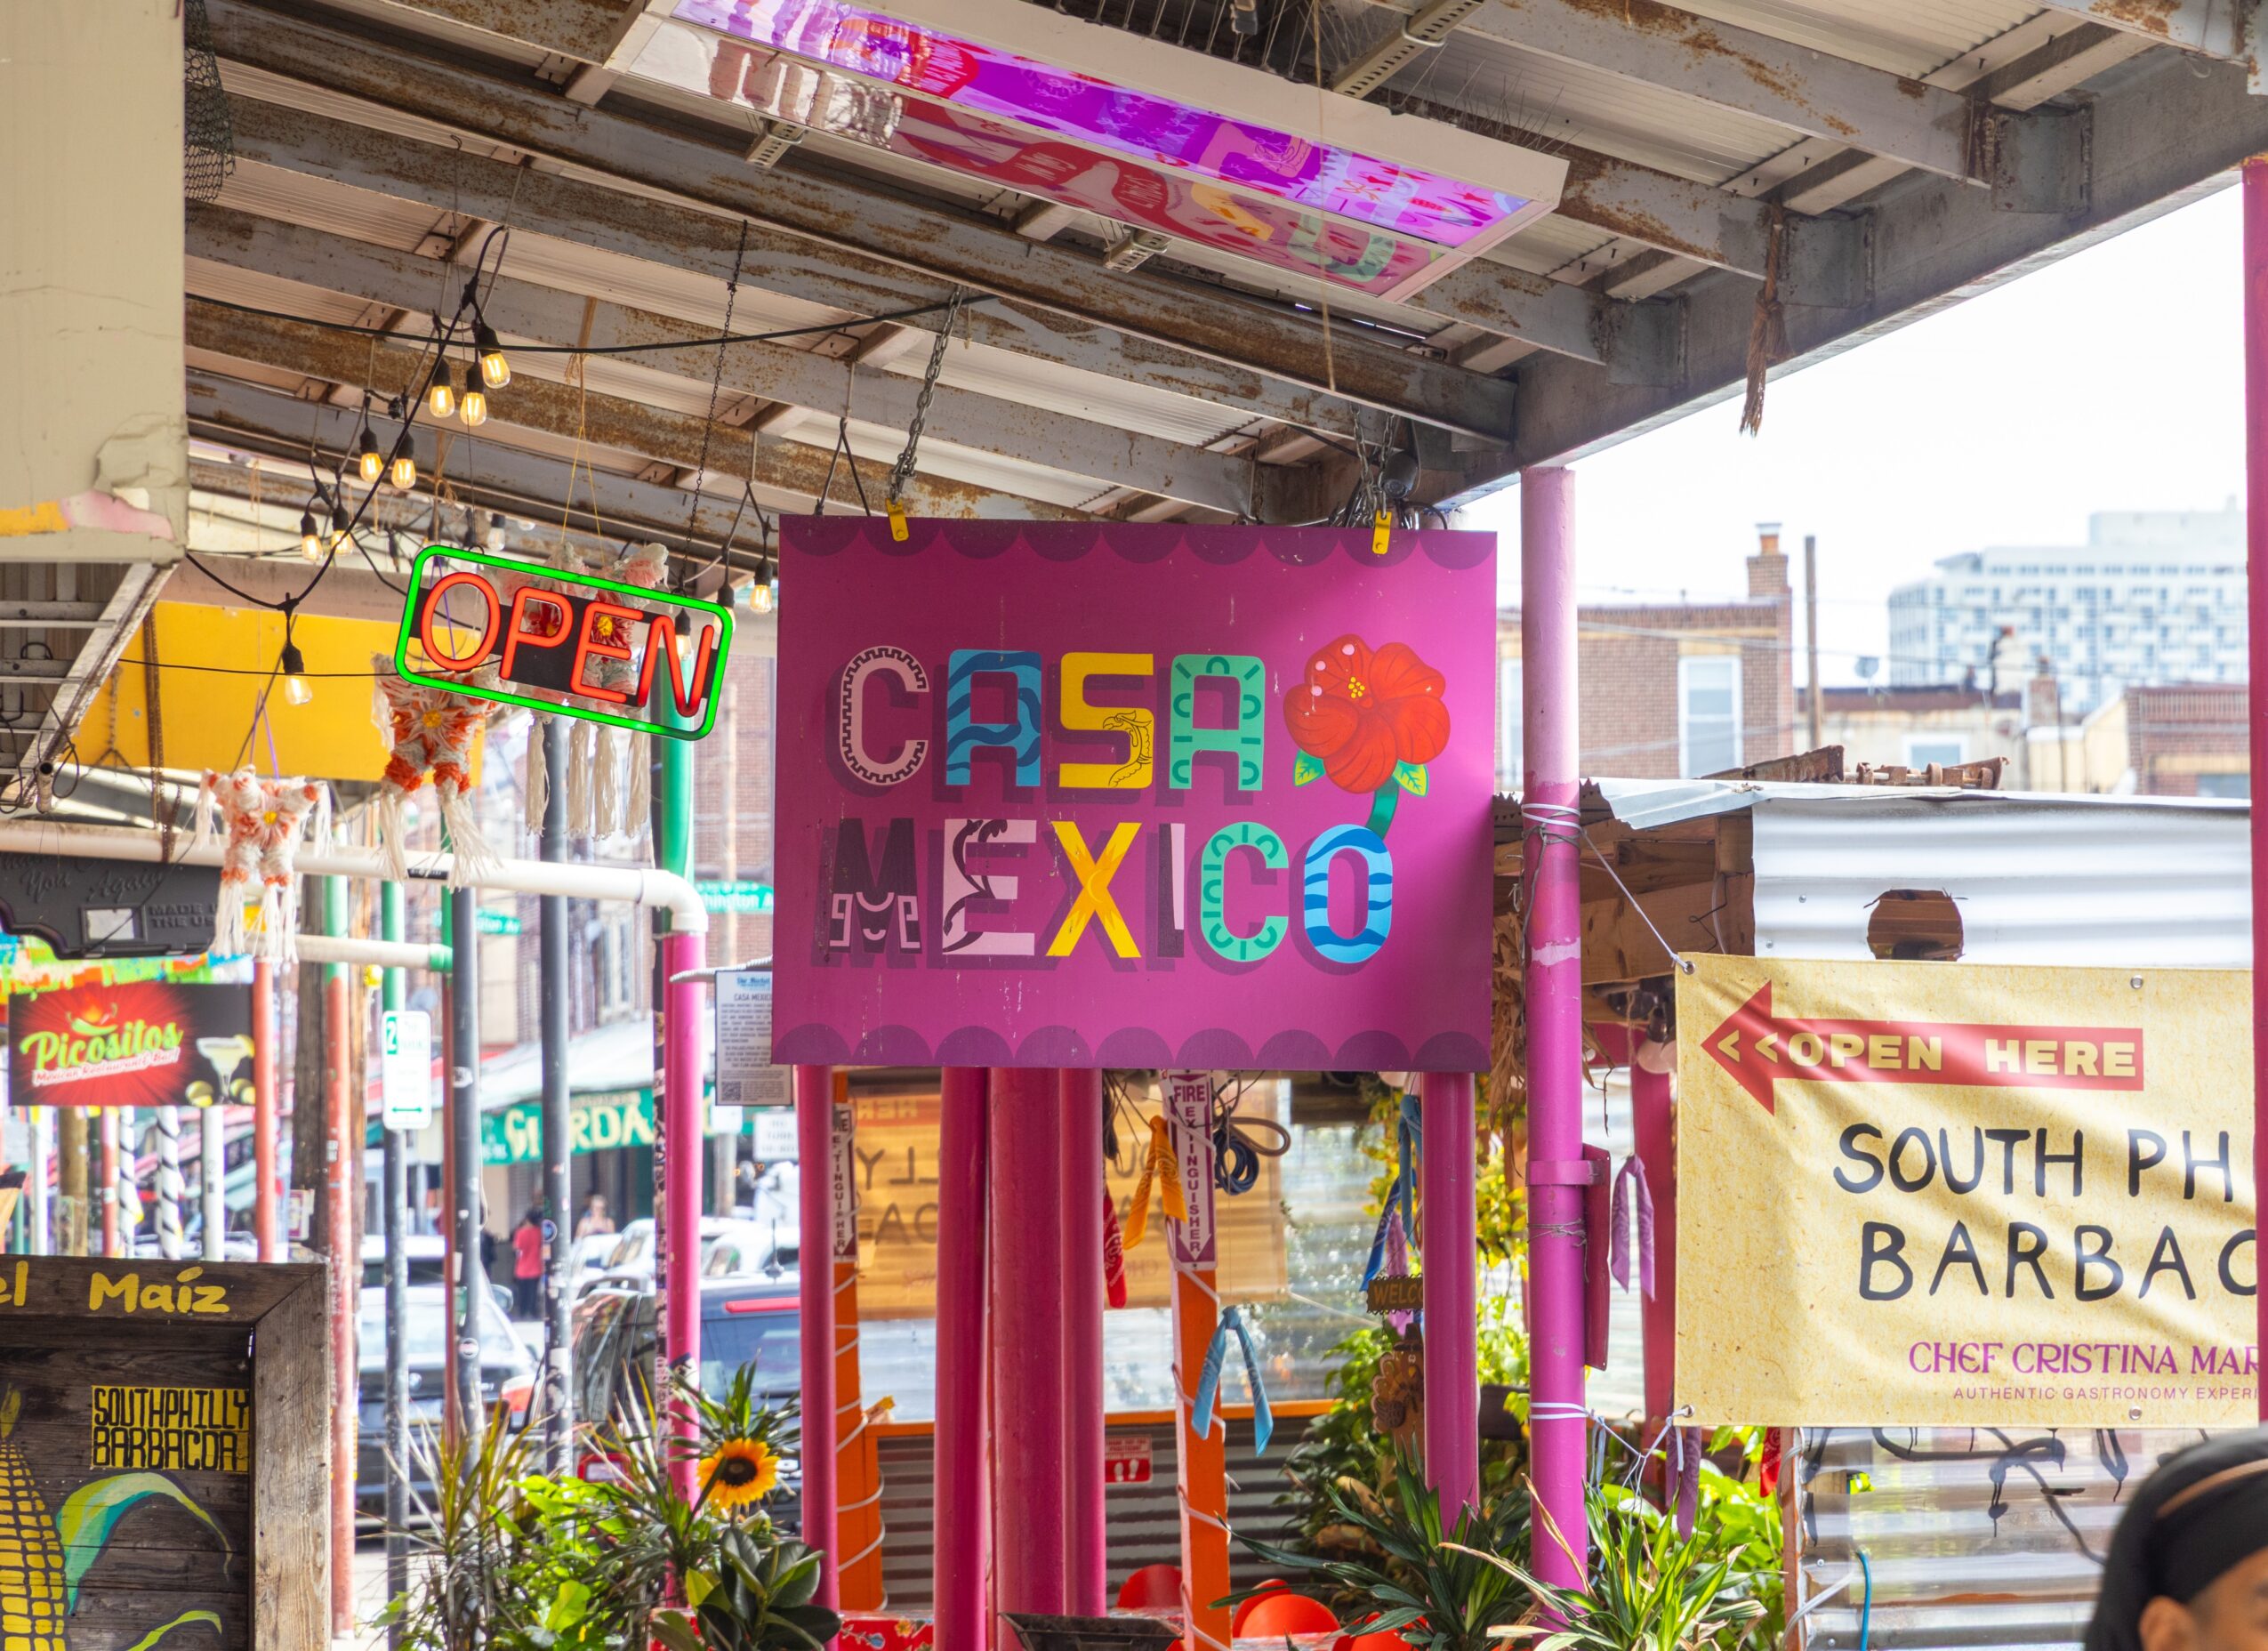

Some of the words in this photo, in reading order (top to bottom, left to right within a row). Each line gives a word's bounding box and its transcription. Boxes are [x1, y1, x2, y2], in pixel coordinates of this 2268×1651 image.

[421, 572, 714, 717] OPEN
[839, 645, 1267, 791] CASA
[827, 817, 1394, 963] MEXICO
[20, 1019, 184, 1071] Picositos
[1984, 1038, 2136, 1078] HERE
[1173, 1084, 1206, 1103] FIRE
[1833, 1123, 2083, 1197] SOUTH
[2128, 1129, 2234, 1203] PH
[89, 1266, 230, 1314] Maíz
[1909, 1341, 2004, 1373] CHEF
[2012, 1341, 2179, 1374] CRISTINA
[1952, 1386, 2056, 1401] AUTHENTIC
[2062, 1386, 2190, 1401] GASTRONOMY
[92, 1426, 238, 1470] BARBACOA
